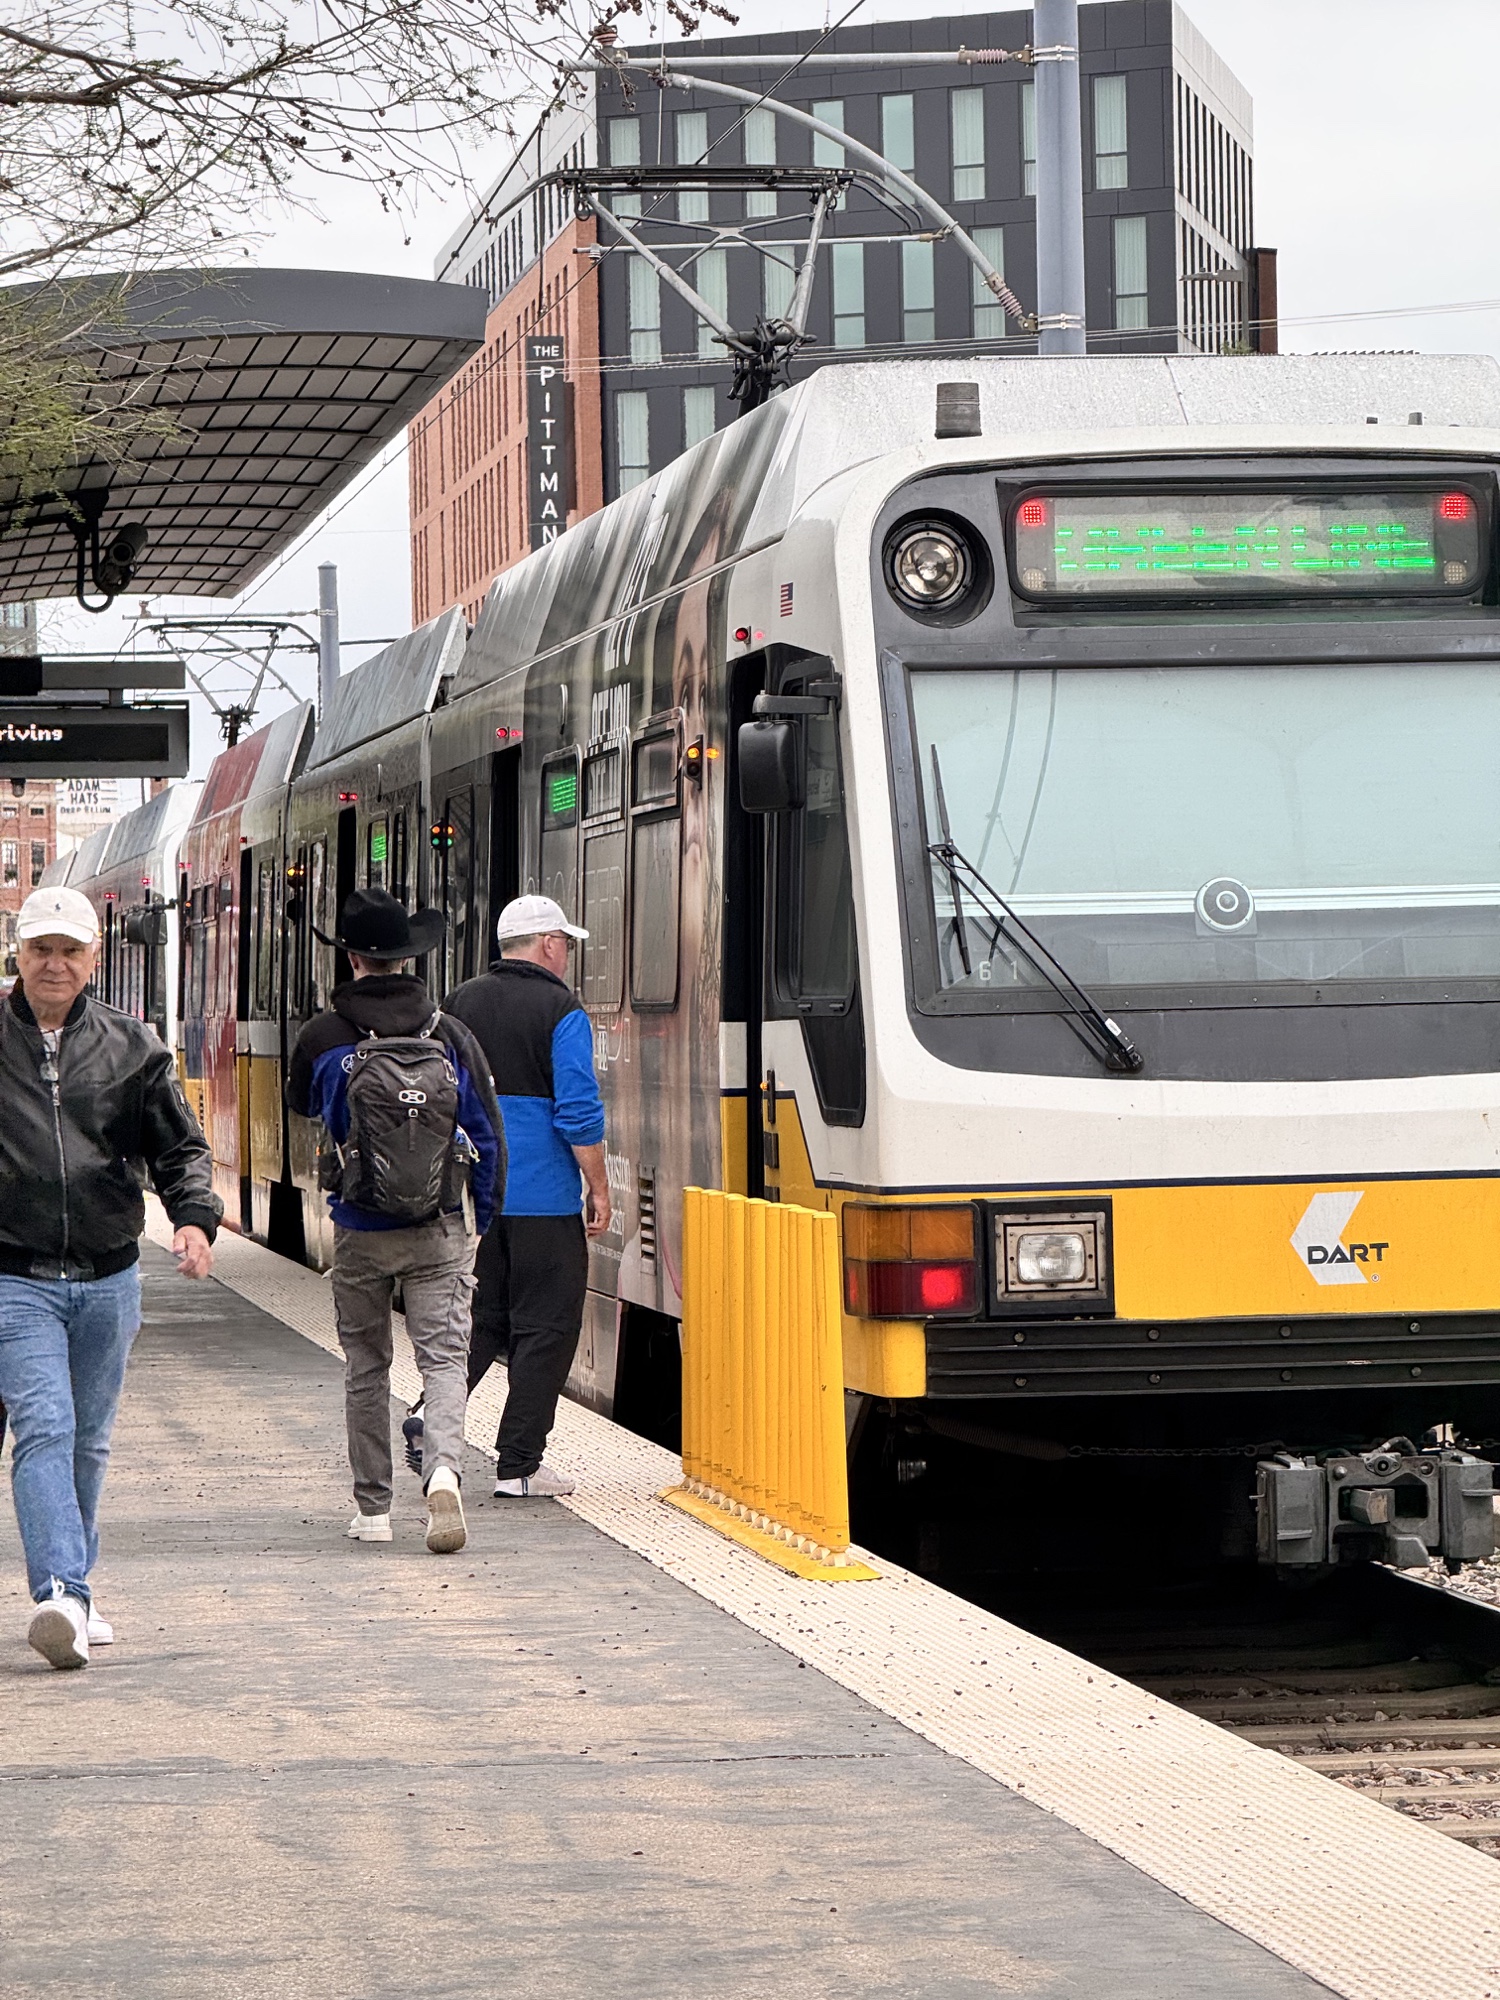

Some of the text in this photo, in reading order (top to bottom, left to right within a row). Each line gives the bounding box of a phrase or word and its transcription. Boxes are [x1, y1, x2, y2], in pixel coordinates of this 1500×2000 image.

[533, 345, 560, 357] THE
[540, 365, 559, 545] PITTMAN
[0, 723, 63, 741] riving
[68, 779, 101, 792] ADAM
[70, 793, 99, 805] HATS
[1307, 1242, 1389, 1264] DART
